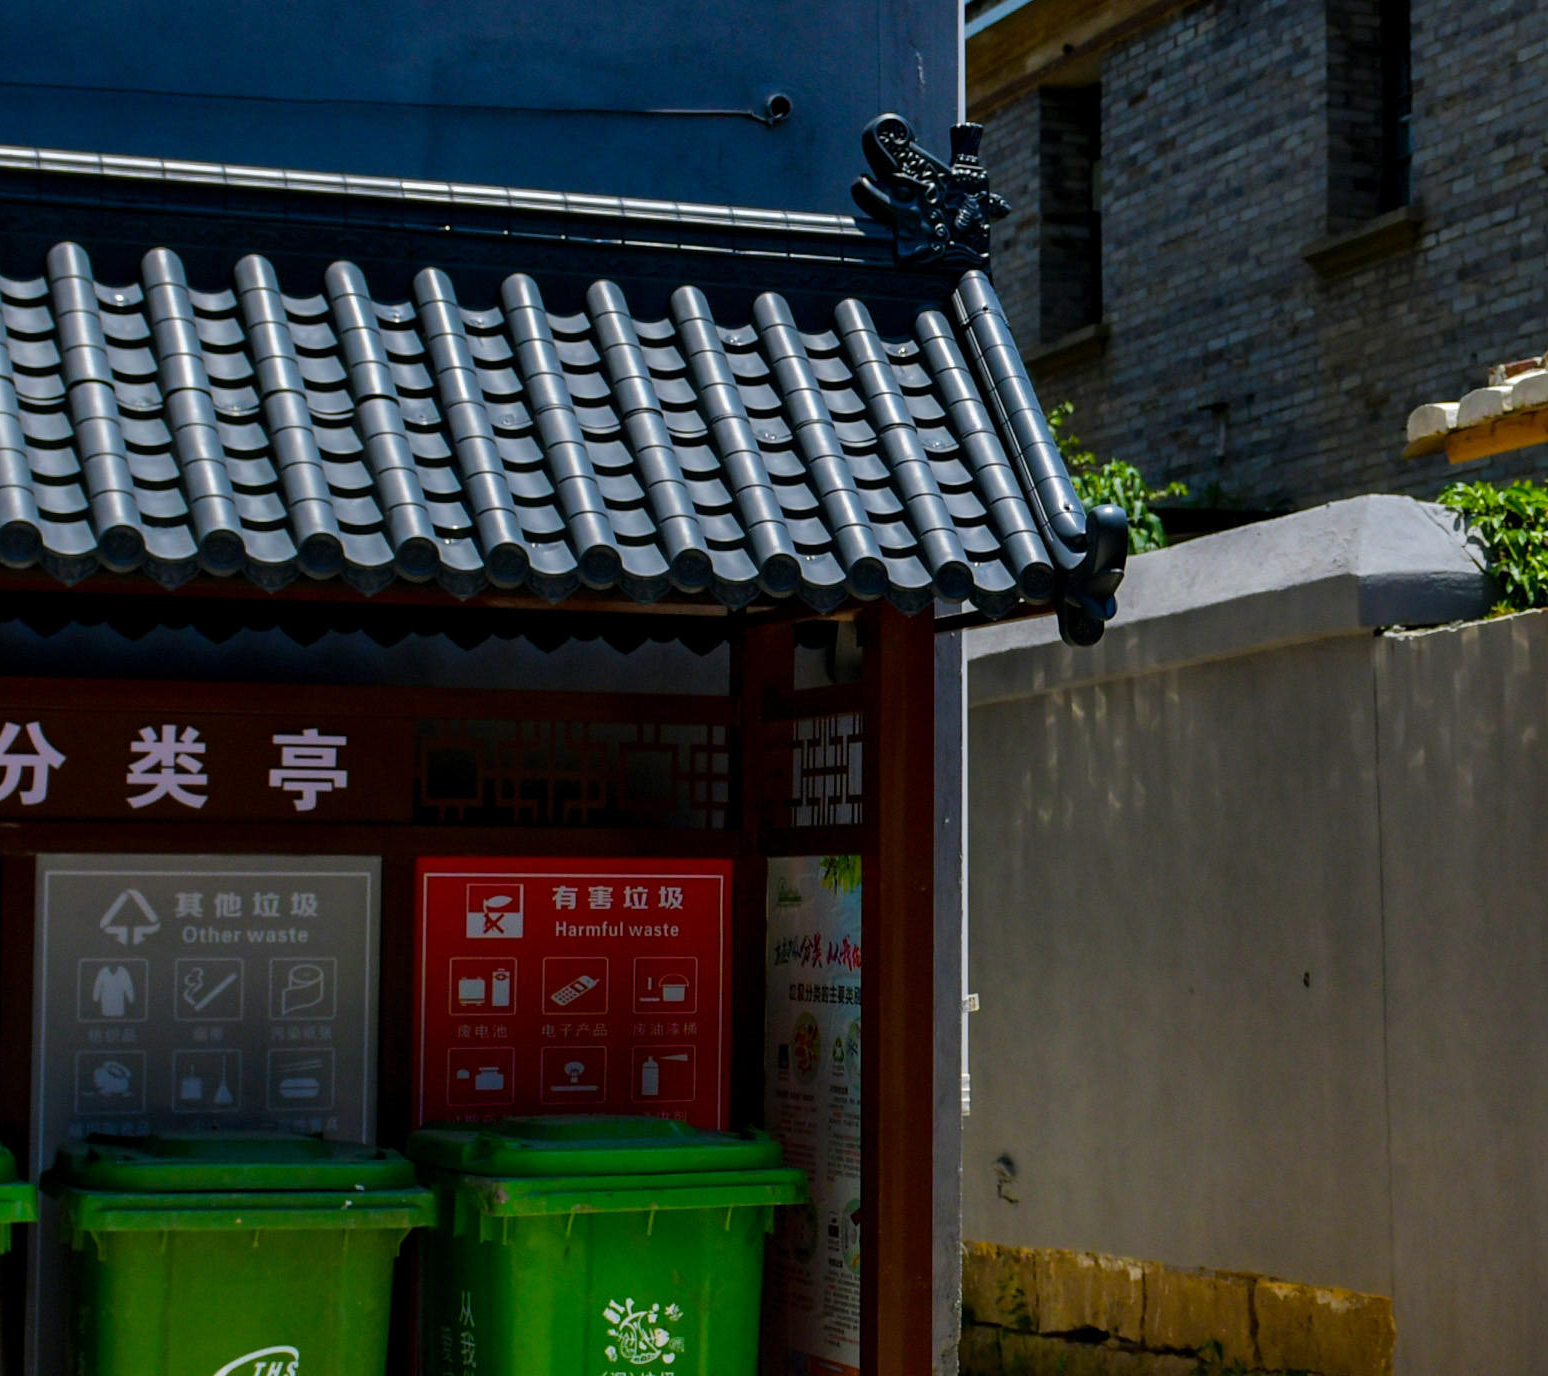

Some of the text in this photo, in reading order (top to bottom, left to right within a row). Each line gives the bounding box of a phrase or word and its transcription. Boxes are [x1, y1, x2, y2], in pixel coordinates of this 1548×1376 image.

[174, 891, 319, 918] 其他垃圾
[551, 885, 685, 911] 有害垃圾
[182, 926, 310, 944] Other waste
[555, 921, 681, 938] Harmful waste
[540, 1023, 609, 1039] 电子产品
